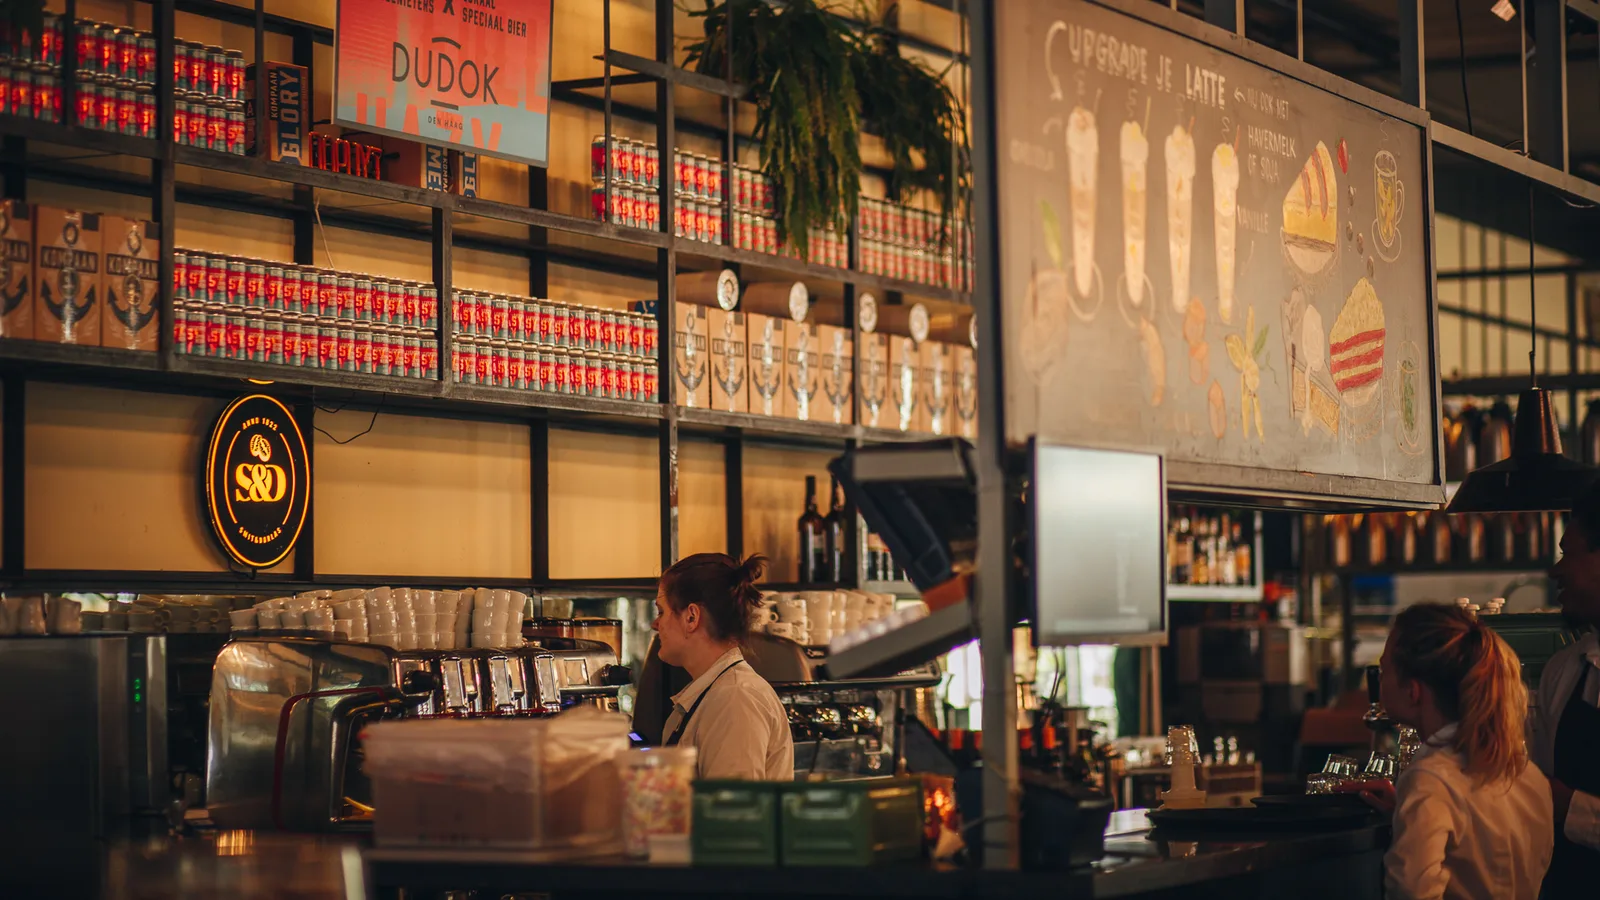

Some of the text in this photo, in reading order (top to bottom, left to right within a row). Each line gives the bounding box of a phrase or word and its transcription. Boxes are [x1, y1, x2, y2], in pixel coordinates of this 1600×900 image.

[462, 7, 527, 37] SPECIAAL BIER
[391, 41, 499, 105] DUDOK
[1068, 23, 1226, 110] UPGRADE JE LATTE
[270, 71, 278, 118] KOMPAAN
[280, 70, 300, 158] GLORY
[427, 115, 464, 131] DEN HAAG
[1247, 124, 1297, 158] HAVERMELK
[1236, 204, 1269, 233] VANILLE
[242, 416, 279, 431] ANNO 1822
[235, 462, 287, 503] S&D
